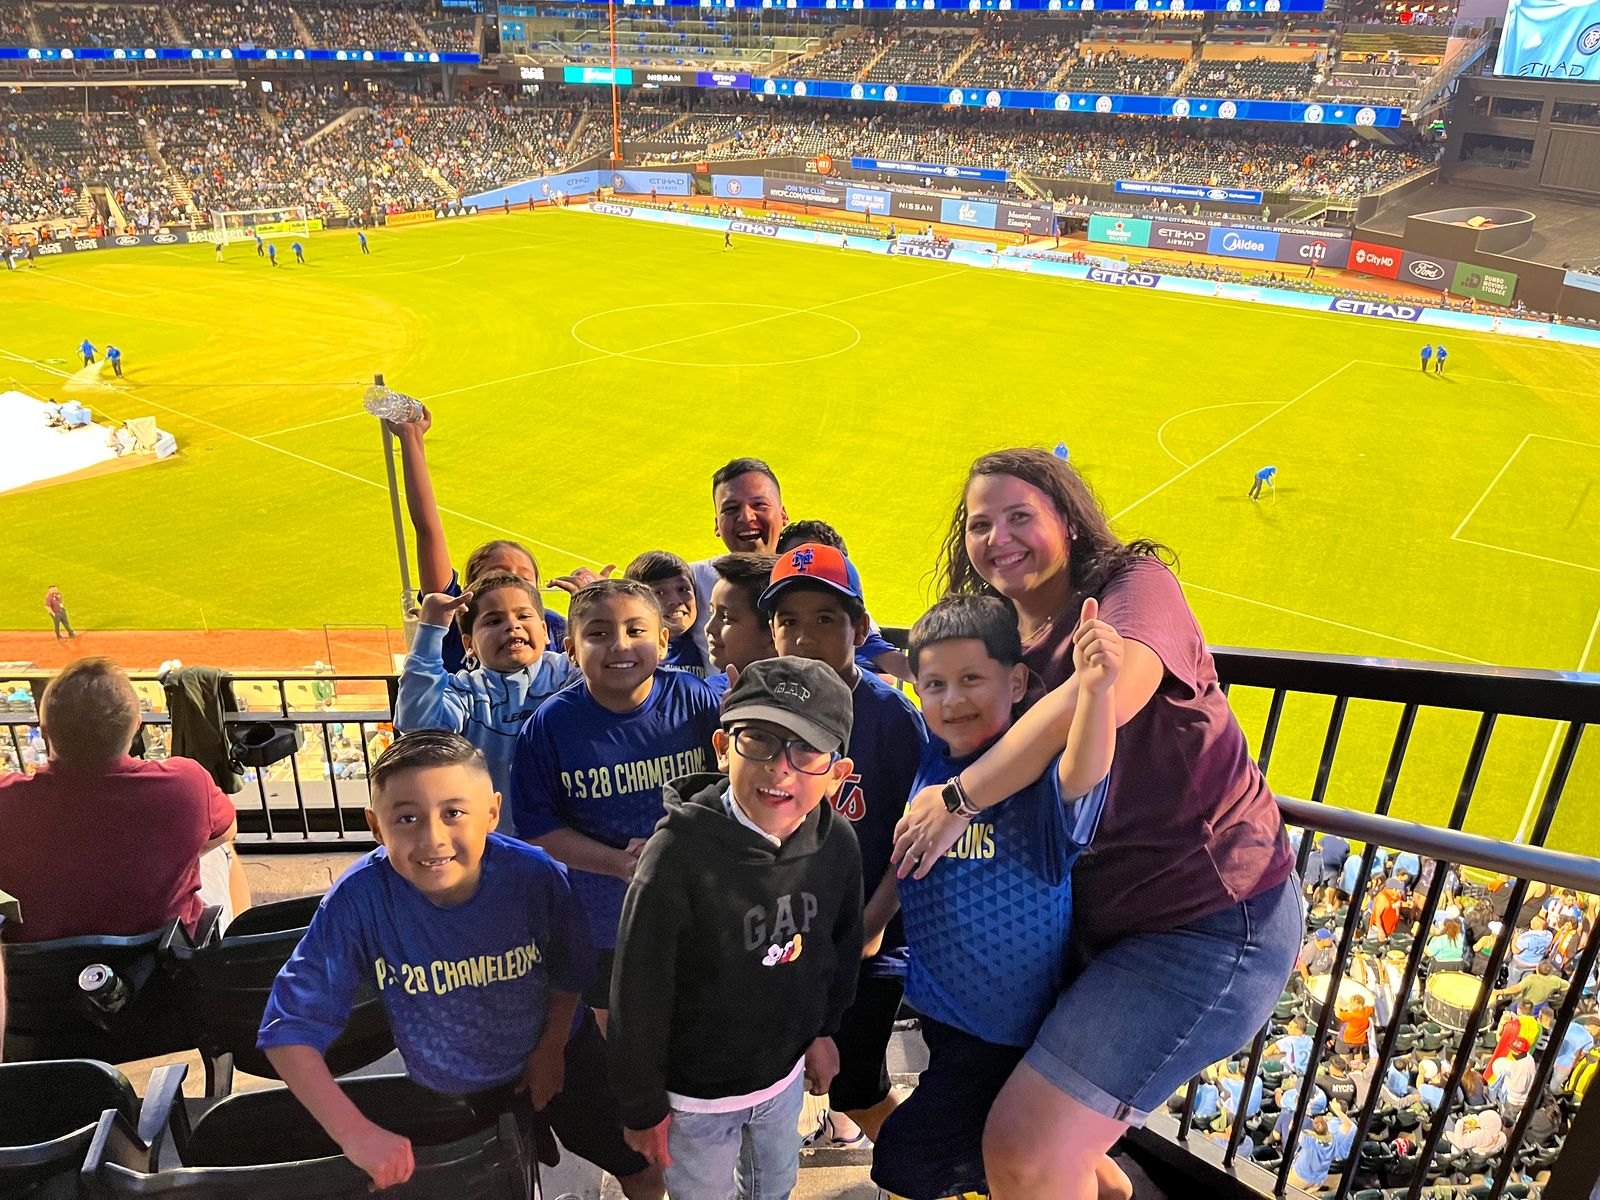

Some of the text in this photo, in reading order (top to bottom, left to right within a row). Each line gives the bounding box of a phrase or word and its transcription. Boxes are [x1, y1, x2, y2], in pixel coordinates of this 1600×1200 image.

[1519, 61, 1585, 78] ETIHAD
[593, 203, 631, 215] ETIHAD
[899, 202, 934, 212] NISSAN
[1007, 210, 1042, 222] Montefiore
[187, 228, 245, 243] Heineken
[730, 222, 775, 236] ETIHAD
[1158, 228, 1206, 241] ETIHAD
[1167, 239, 1194, 247] AIRWAYS
[1226, 236, 1265, 251] Midea
[1299, 241, 1327, 259] citi
[890, 244, 947, 259] ETIHAD
[1091, 268, 1155, 286] ETIHAD
[1414, 262, 1439, 278] Ford
[1484, 275, 1505, 284] DUMBO
[1482, 286, 1507, 296] STORAGE
[1335, 297, 1416, 320] ETIHAD
[773, 682, 811, 702] GAP
[588, 766, 613, 799] 28
[614, 747, 707, 795] CHAMELEON
[743, 892, 818, 951] GAP
[401, 963, 429, 995] 28
[430, 938, 542, 995] CHAMELEON
[1331, 1083, 1354, 1093] NYCFC
